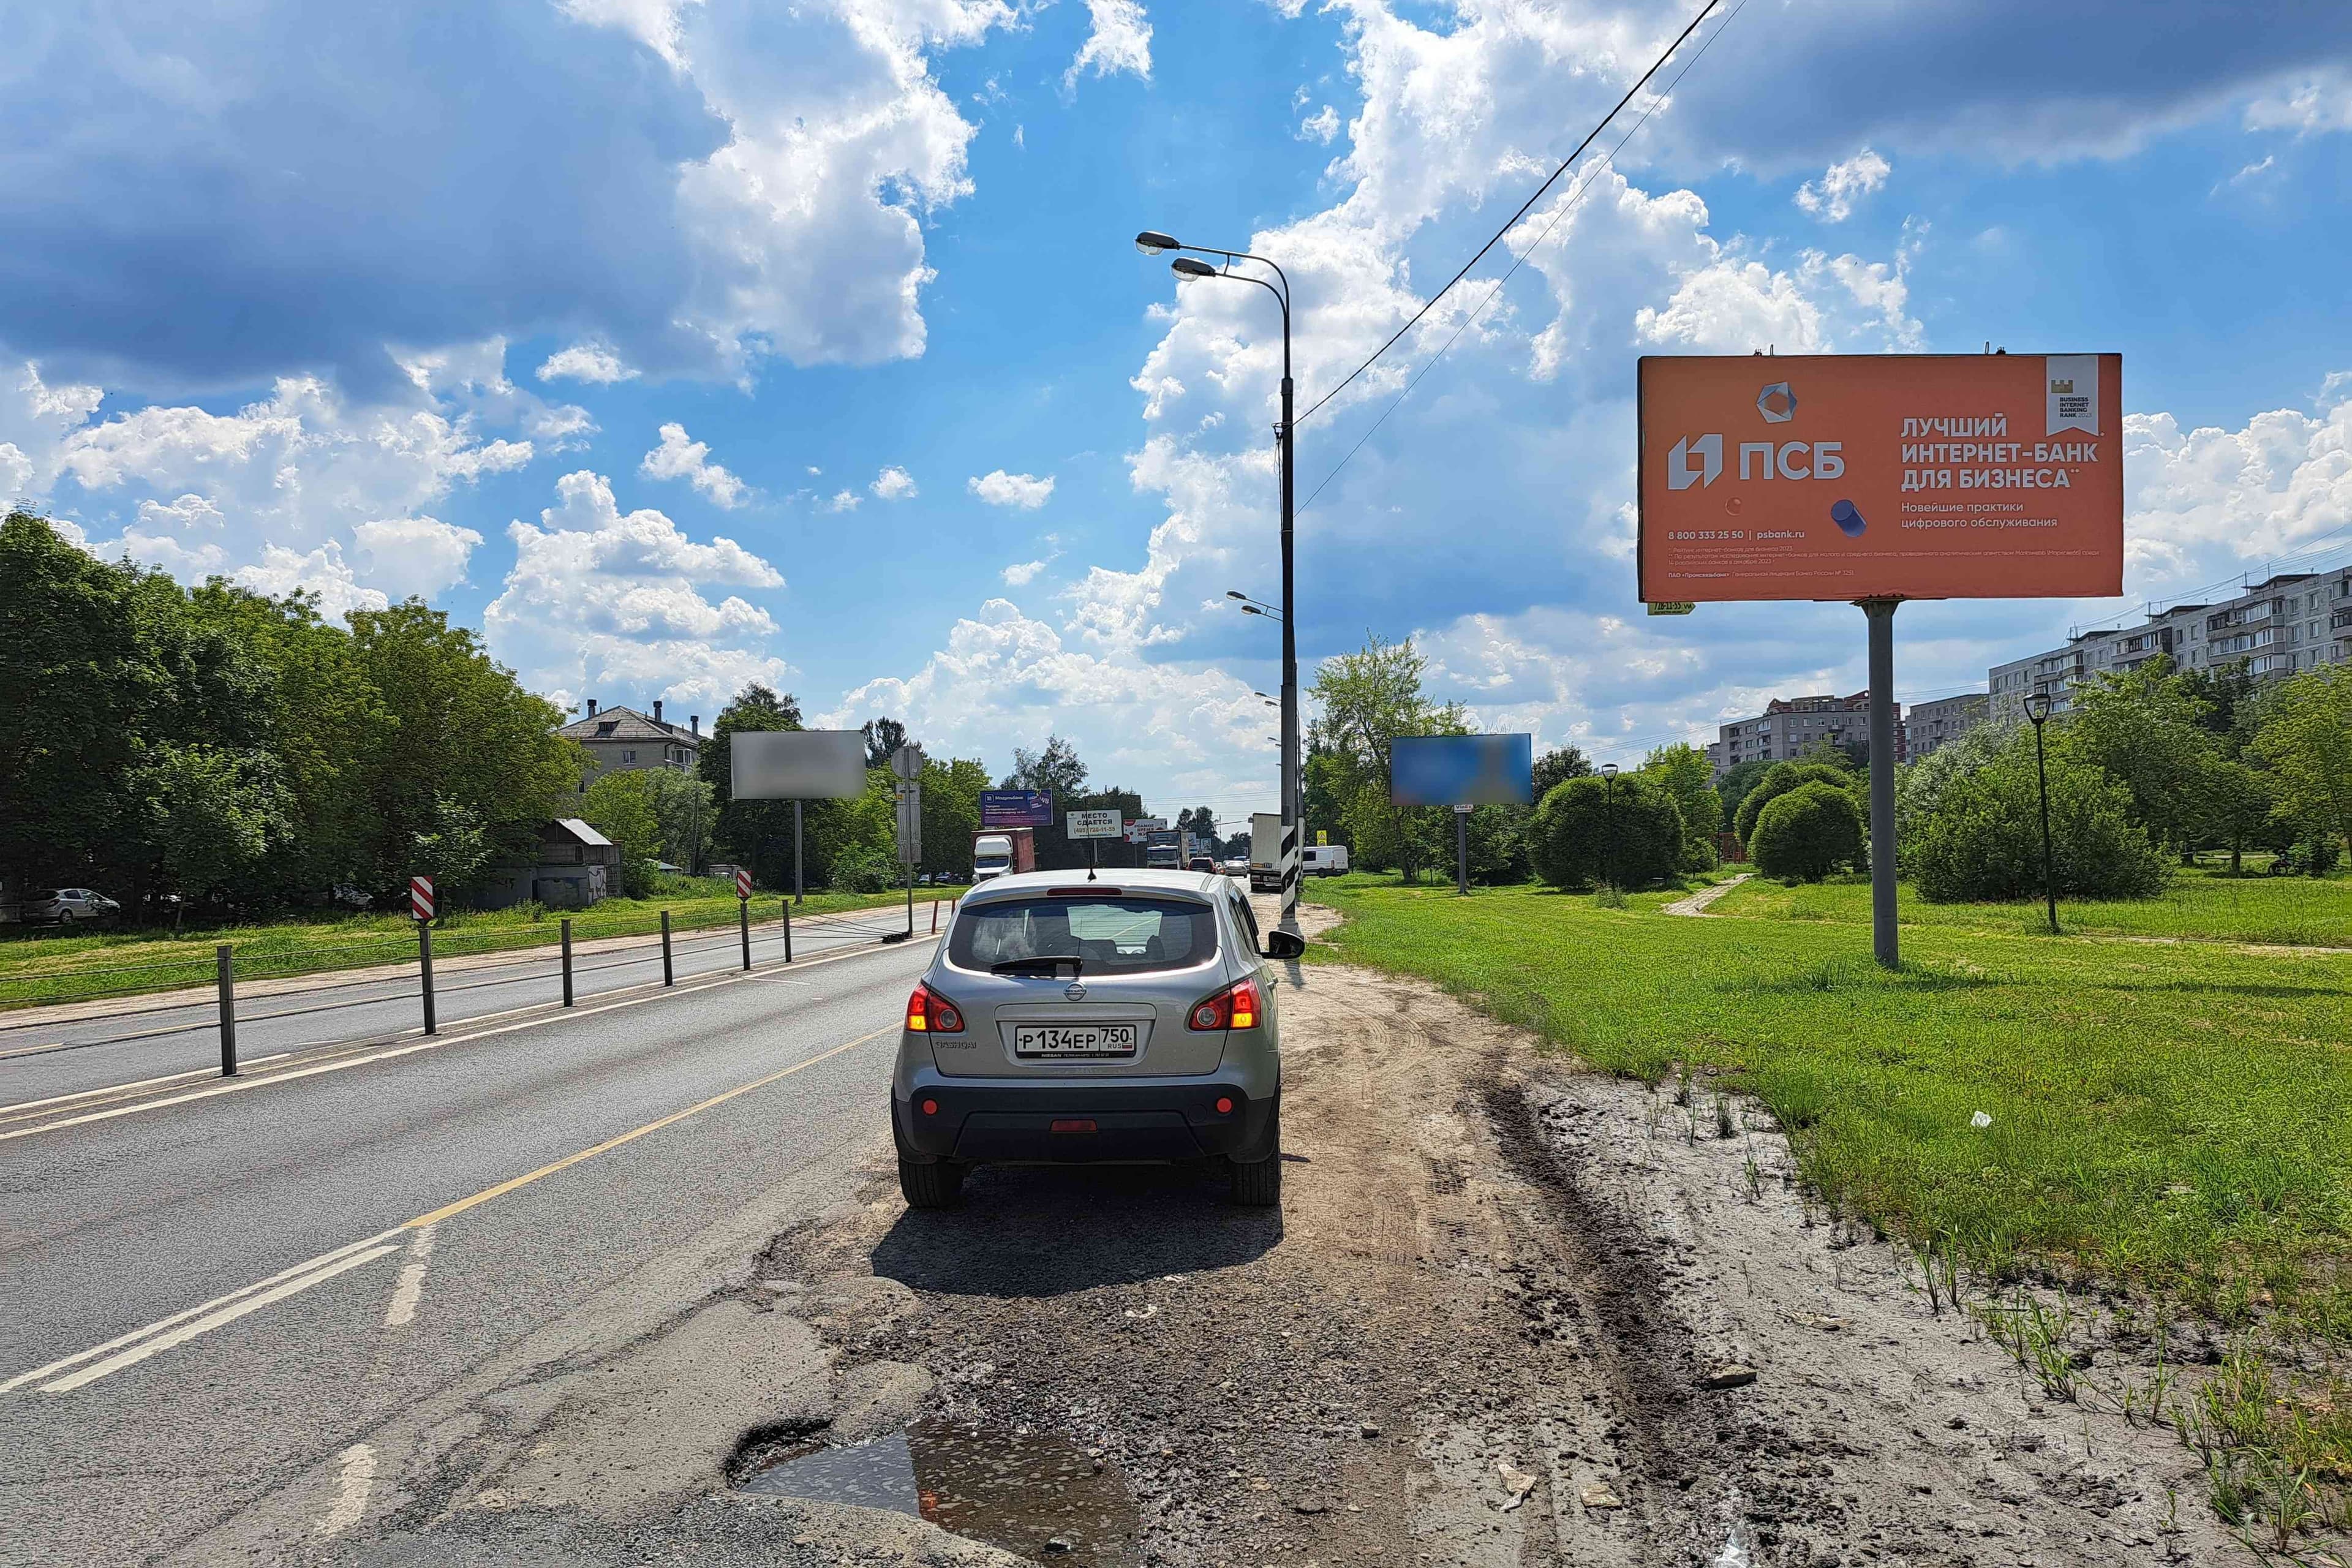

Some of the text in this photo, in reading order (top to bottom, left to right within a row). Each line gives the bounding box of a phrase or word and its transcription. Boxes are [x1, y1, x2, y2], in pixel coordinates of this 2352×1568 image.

[1901, 412, 2007, 438] ЛУЧШИЙ
[1739, 440, 1845, 481] ПСБ
[1901, 443, 2099, 463] ИНТЕРНЕТ-БАНК
[1901, 469, 1952, 492] ДЛЯ
[1901, 502, 2024, 514] Новейшие практики
[1901, 517, 2058, 530] цифрового обслуживания
[1668, 531, 1675, 540] 8
[1676, 531, 1696, 540] 800
[1698, 530, 1716, 539] 333
[1717, 530, 1729, 539] 25
[1732, 530, 1744, 539] 50
[1757, 529, 1805, 540] psbank.ru
[1101, 1028, 1129, 1043] 750
